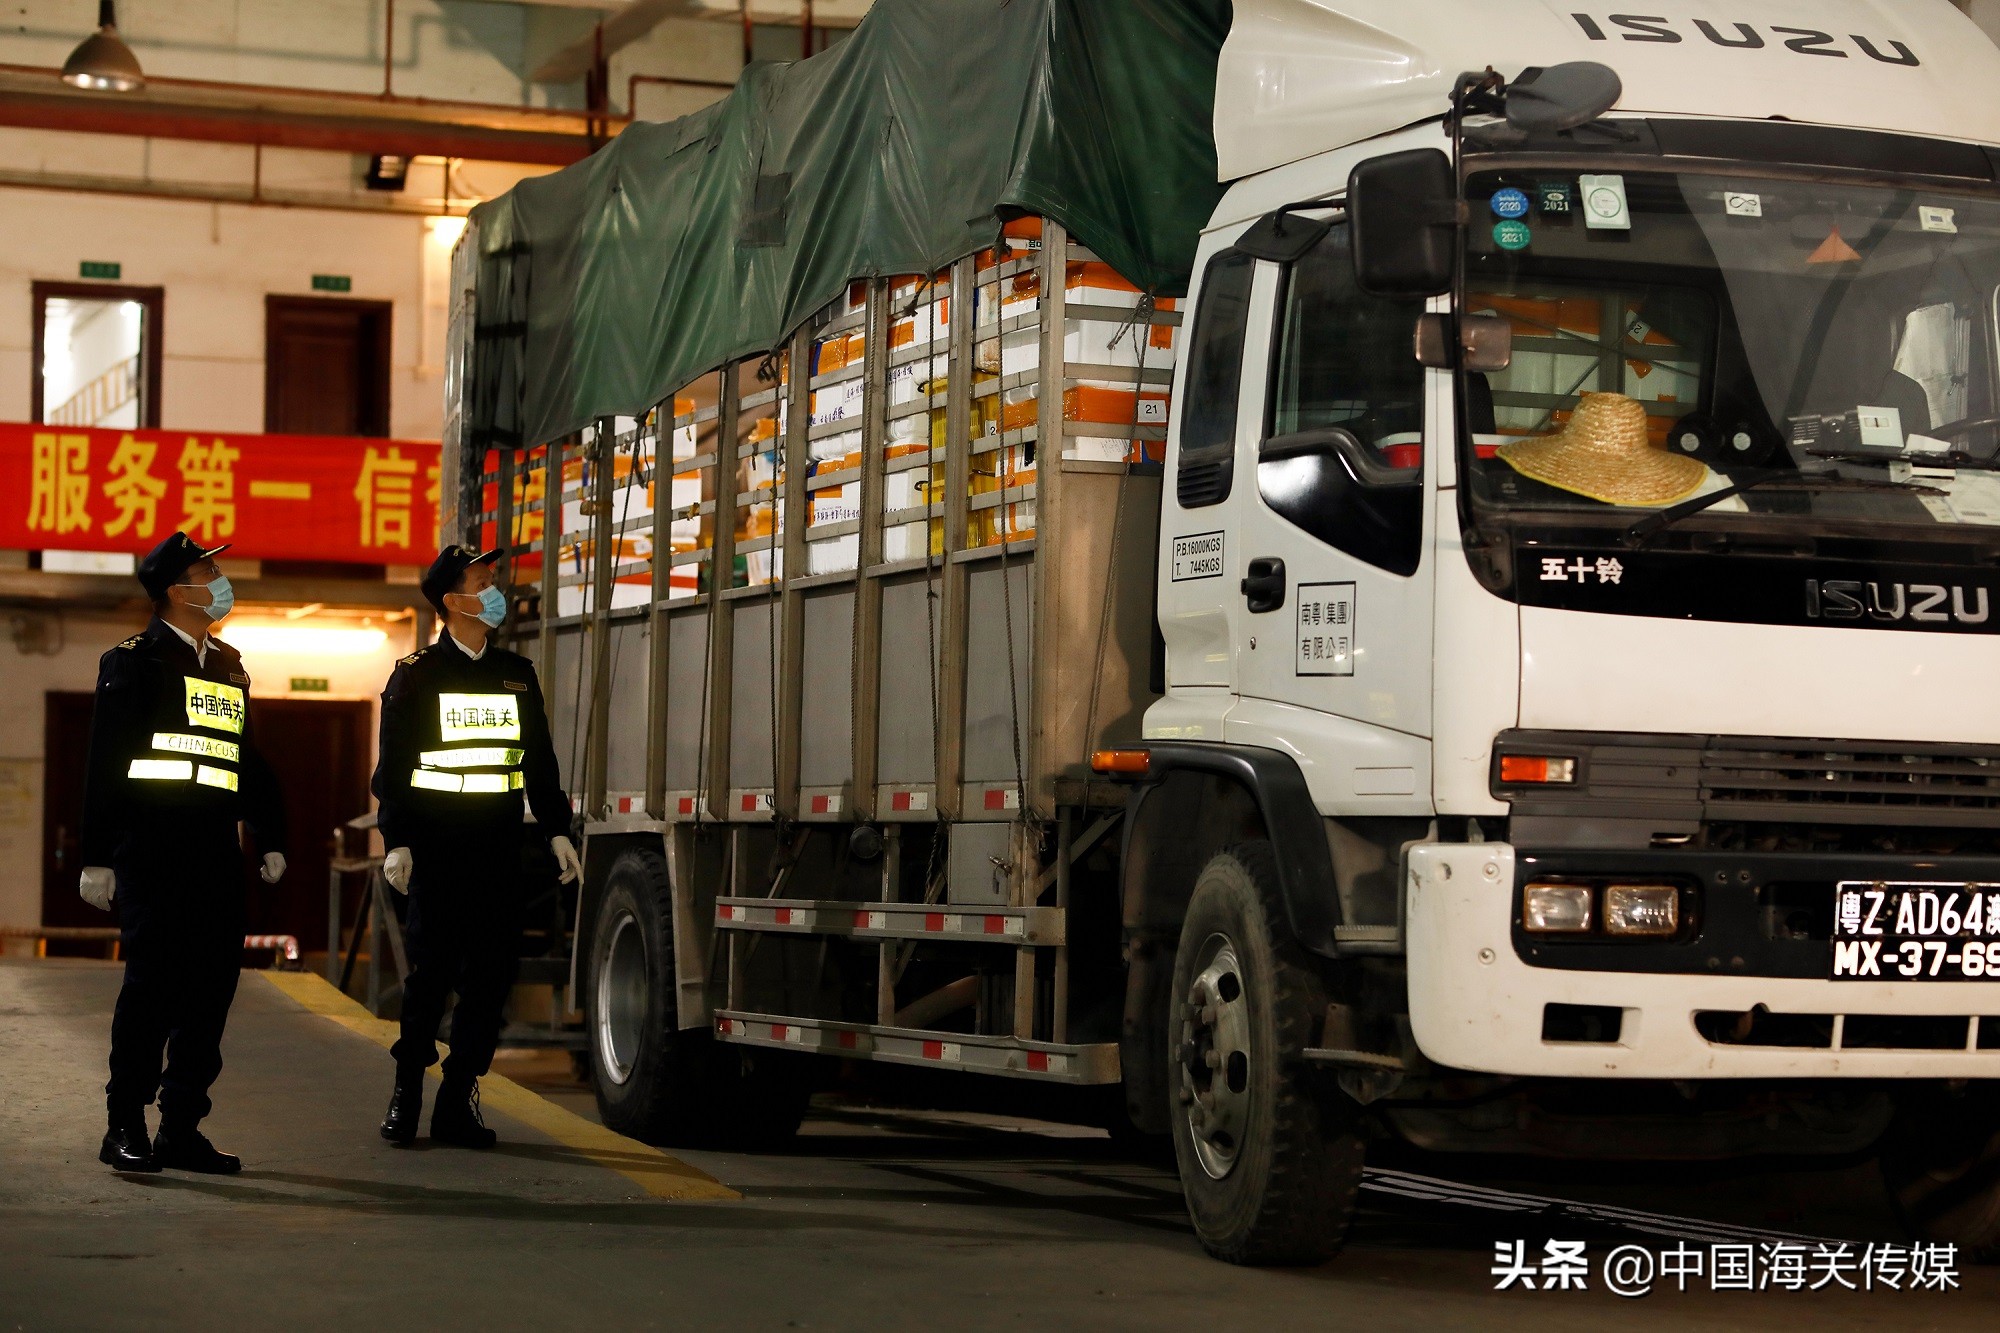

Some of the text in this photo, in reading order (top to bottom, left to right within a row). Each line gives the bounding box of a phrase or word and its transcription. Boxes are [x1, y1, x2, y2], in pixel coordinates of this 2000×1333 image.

[1571, 13, 1920, 66] ISUZU
[1499, 201, 1521, 211] 2020
[1543, 200, 1569, 211] 2021
[1501, 232, 1523, 243] 2021
[1145, 404, 1158, 414] 21
[27, 433, 311, 541] 服务第一
[1540, 557, 1623, 584] 五十铃
[1805, 579, 1990, 623] ISUZU
[1302, 637, 1348, 660] 有限公司
[190, 692, 243, 721] 中国海关
[446, 707, 515, 728] 中国海关
[168, 735, 213, 754] CHINA
